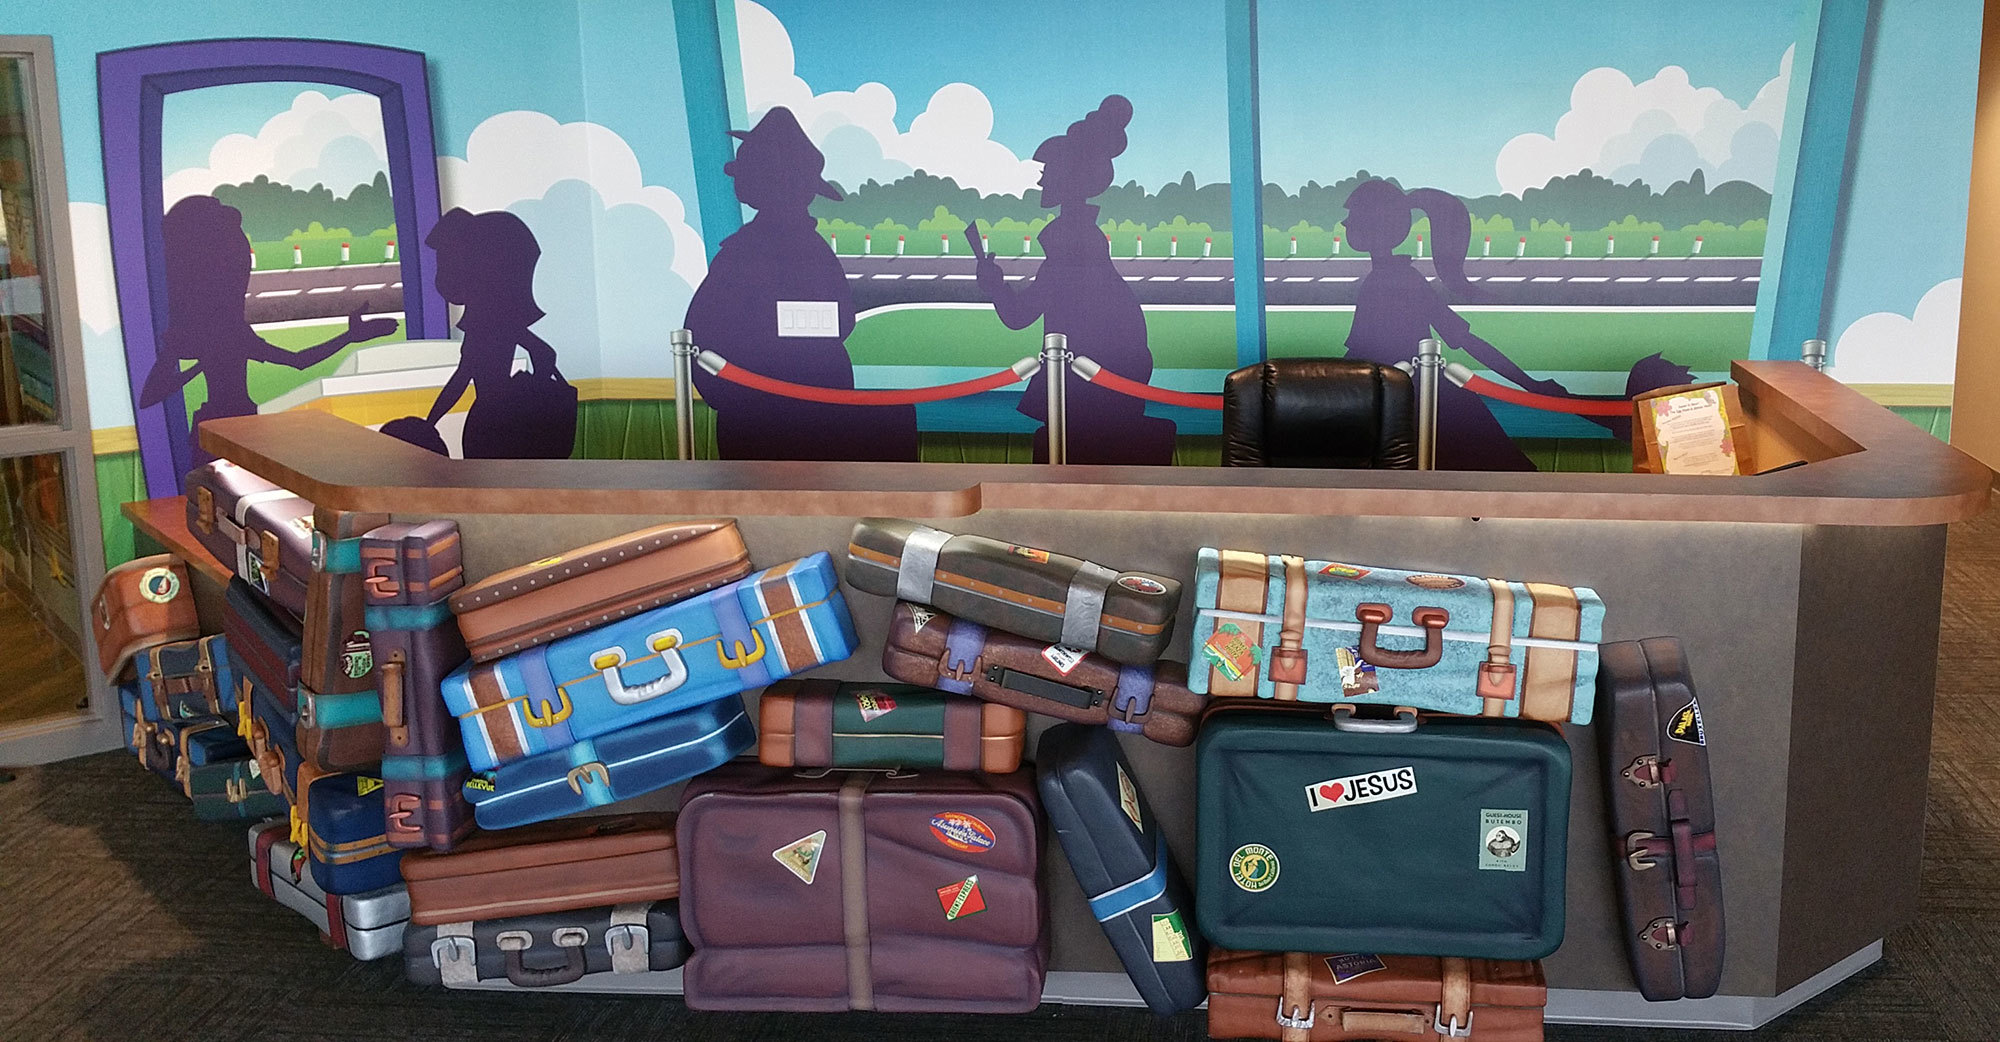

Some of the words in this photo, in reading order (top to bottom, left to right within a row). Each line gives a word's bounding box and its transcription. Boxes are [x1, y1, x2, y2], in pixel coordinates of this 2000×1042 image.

[1309, 787, 1319, 807] I
[1343, 769, 1414, 802] JESUS
[1233, 854, 1246, 868] DEL
[1244, 846, 1274, 861] MONTE
[1234, 870, 1258, 889] HOTEL
